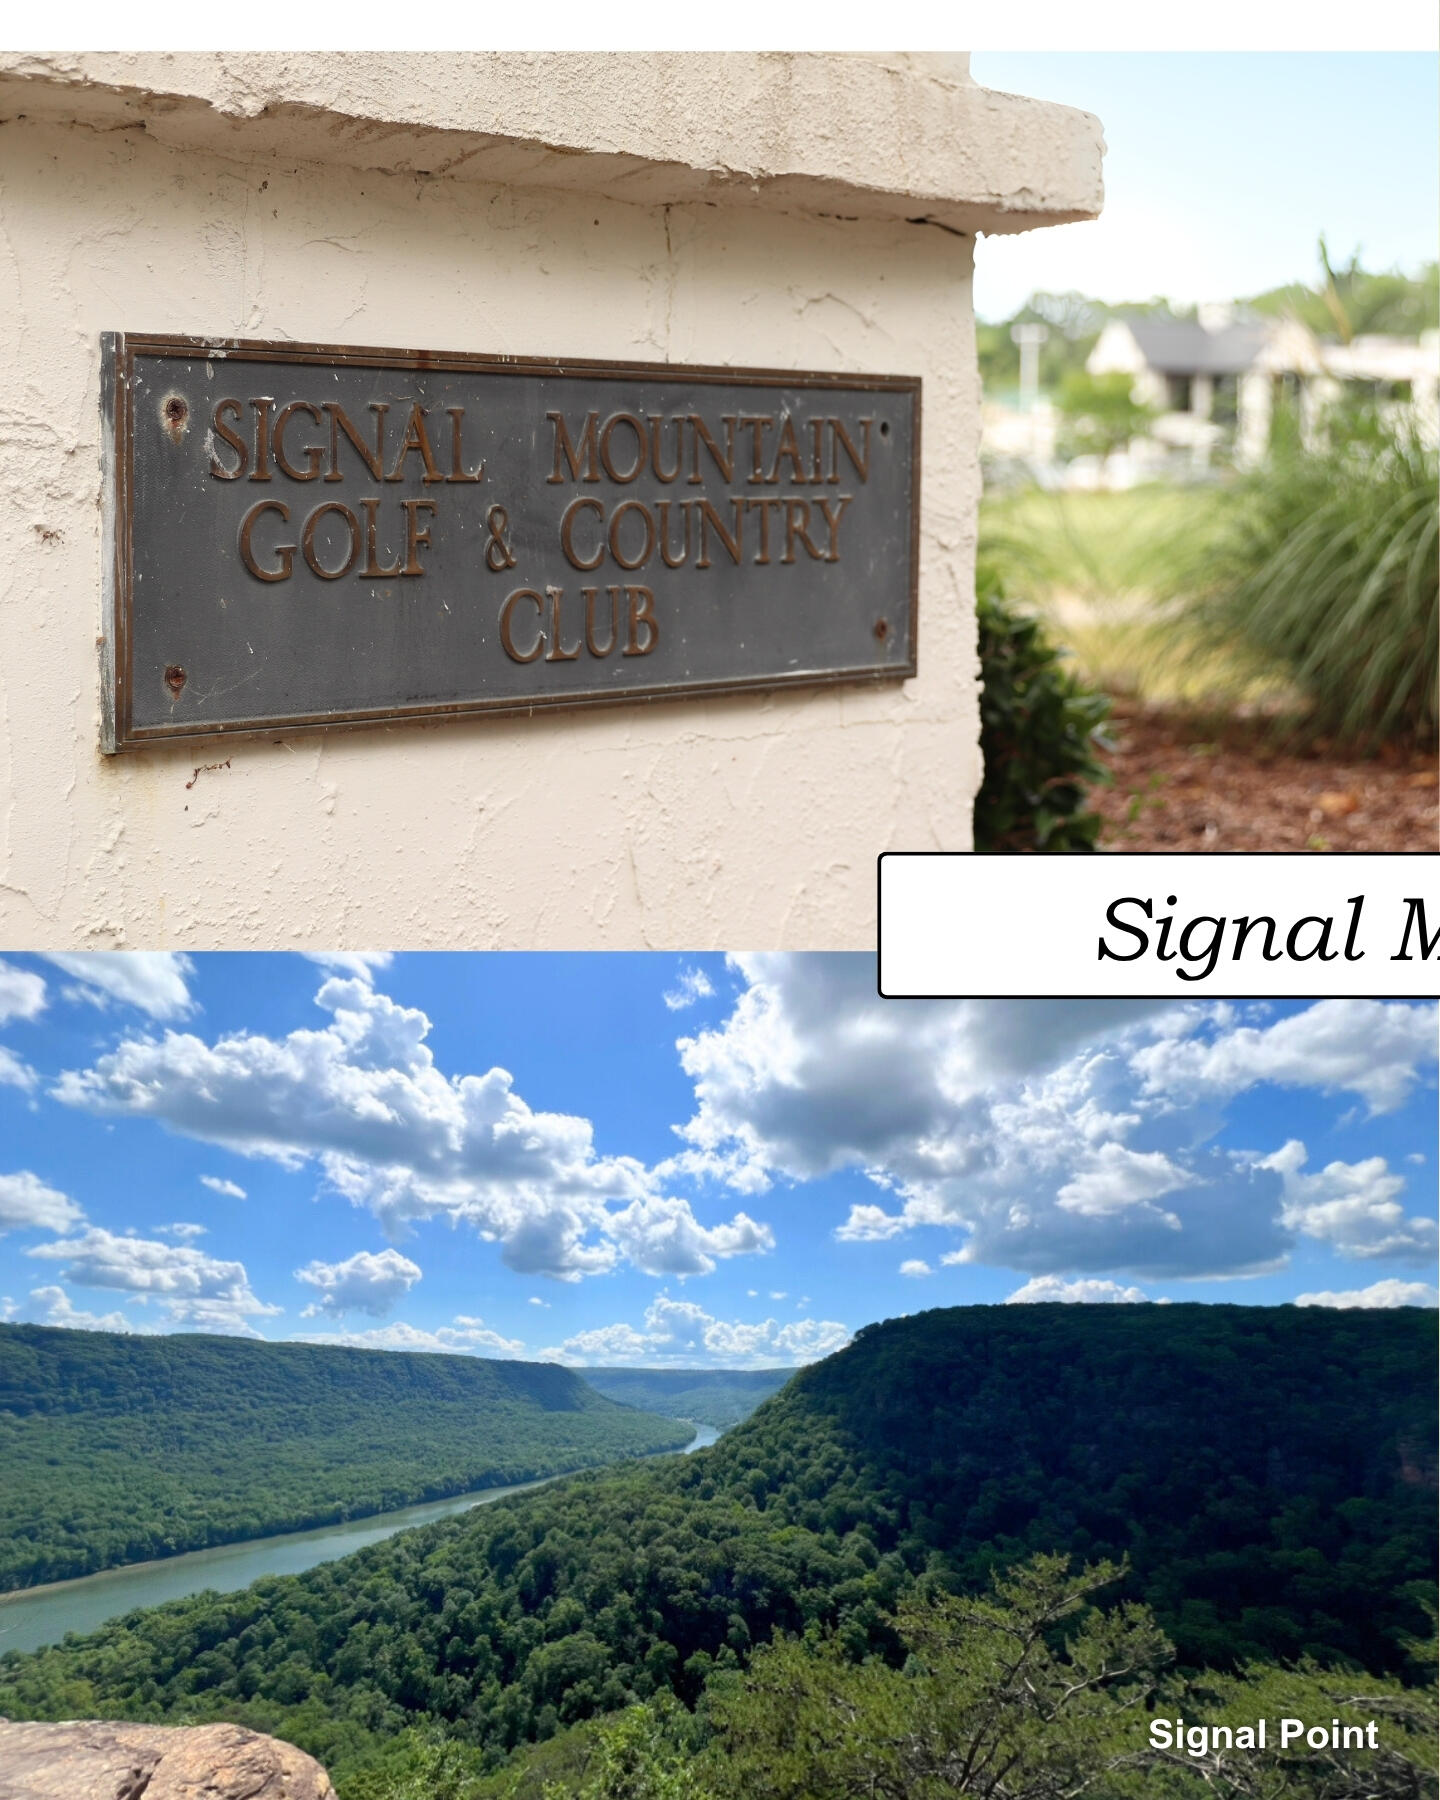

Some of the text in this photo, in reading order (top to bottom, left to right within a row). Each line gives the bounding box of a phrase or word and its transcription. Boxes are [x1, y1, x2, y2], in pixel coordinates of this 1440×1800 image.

[209, 398, 872, 485] SIGNAL MOUNTAIN
[239, 494, 852, 582] GOLF & COUNTRY
[499, 585, 659, 662] CLUB
